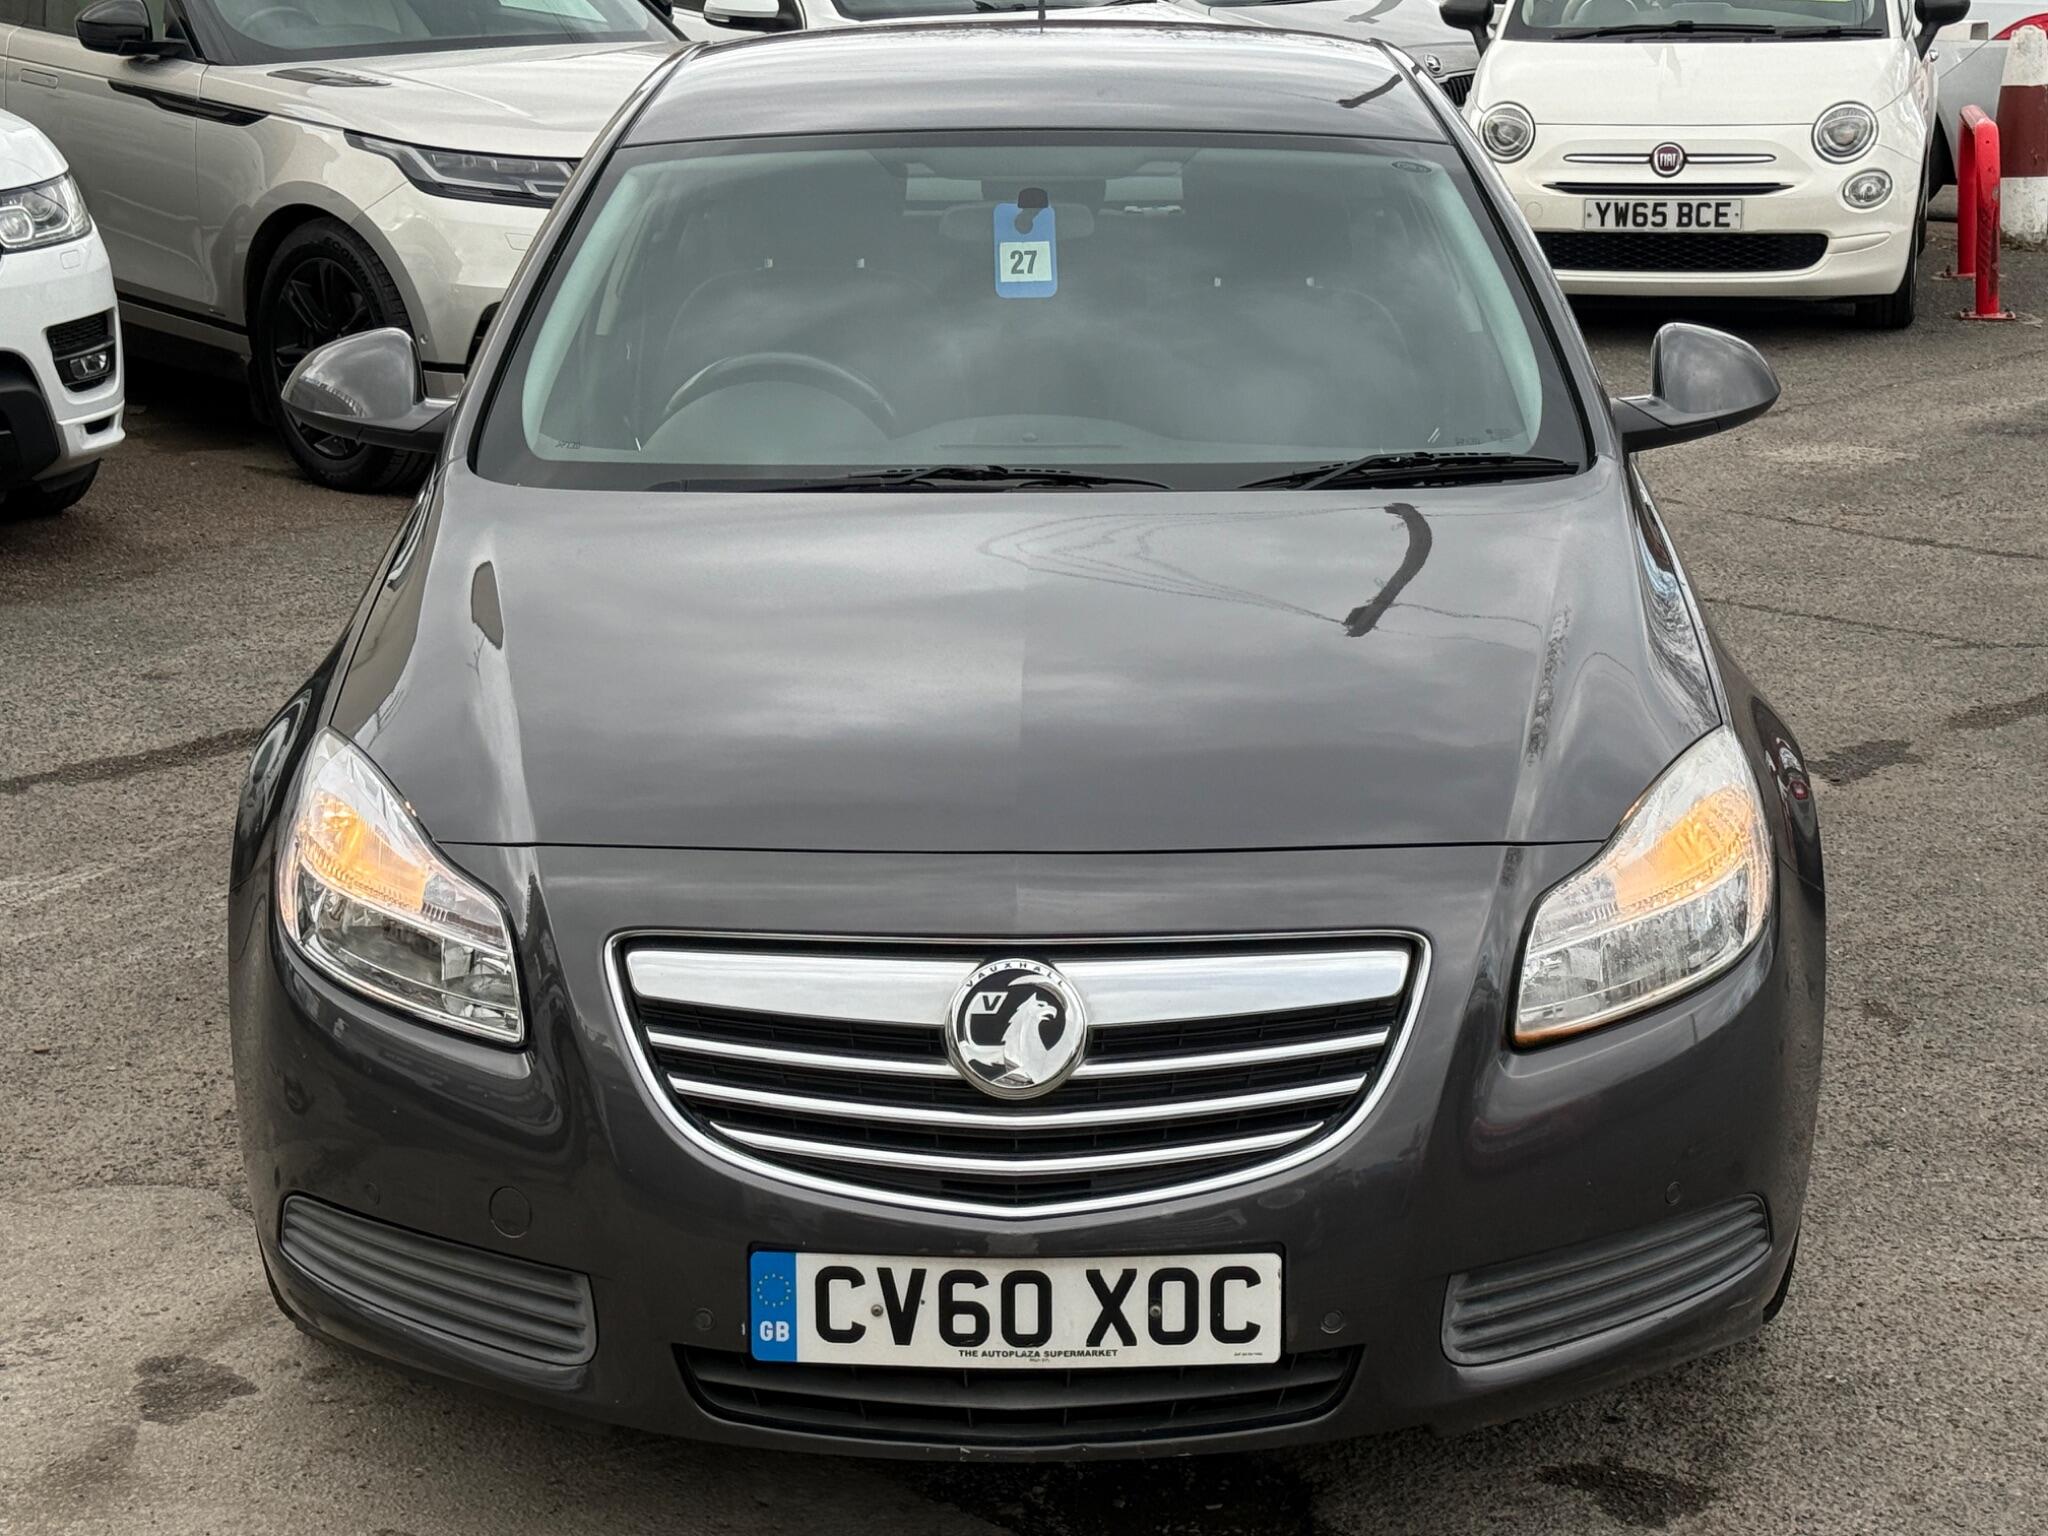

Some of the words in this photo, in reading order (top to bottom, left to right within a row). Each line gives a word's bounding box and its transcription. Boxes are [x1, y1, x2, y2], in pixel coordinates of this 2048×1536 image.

[1660, 153, 1678, 166] FIAT
[1595, 202, 1668, 228] YW65
[1676, 202, 1732, 228] BCE
[1010, 250, 1037, 274] 27
[965, 962, 1064, 988] VAUXHALL
[814, 1265, 1053, 1348] CV60
[1085, 1265, 1262, 1348] XOC
[759, 1319, 790, 1343] GB
[958, 1349, 979, 1358] THE
[981, 1349, 1040, 1358] AUTOPLAZA
[1043, 1349, 1119, 1358] SUPERMARKET
